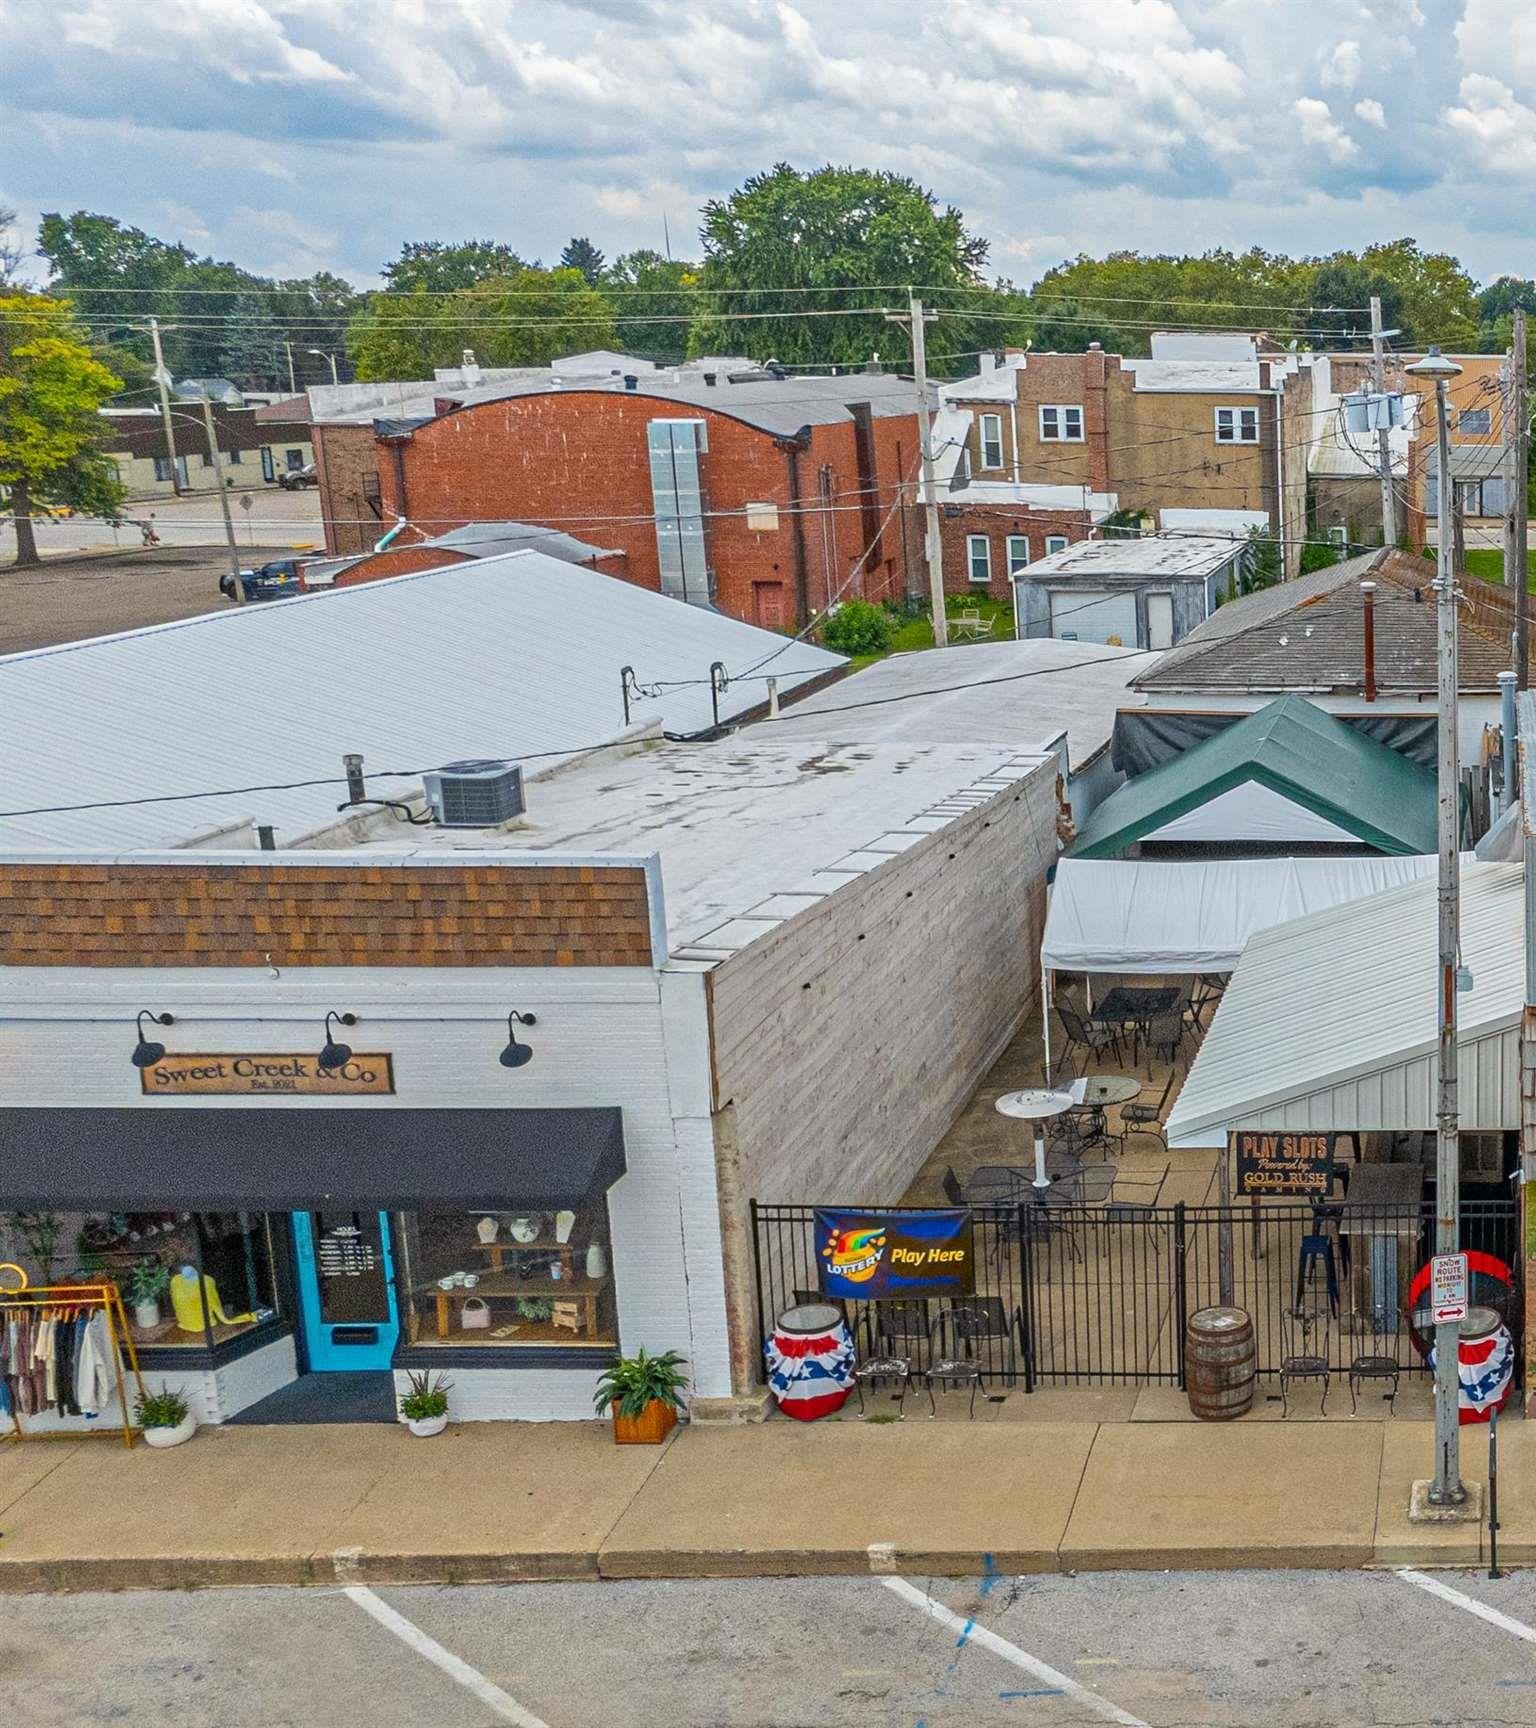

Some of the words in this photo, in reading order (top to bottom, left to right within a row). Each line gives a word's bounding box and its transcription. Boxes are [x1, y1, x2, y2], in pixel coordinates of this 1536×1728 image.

[155, 1063, 227, 1086] Sweet
[233, 1058, 310, 1080] Creek
[316, 1061, 338, 1080] &
[340, 1062, 377, 1084] Co
[1243, 1136, 1279, 1159] PLAY
[1283, 1136, 1328, 1159] SLOTS
[1244, 1172, 1284, 1184] GOLD
[1289, 1172, 1328, 1184] RUSH
[827, 1248, 884, 1275] LOTTERY
[891, 1249, 926, 1266] Play
[927, 1248, 965, 1263] Here
[1437, 1266, 1462, 1276] ROUTE
